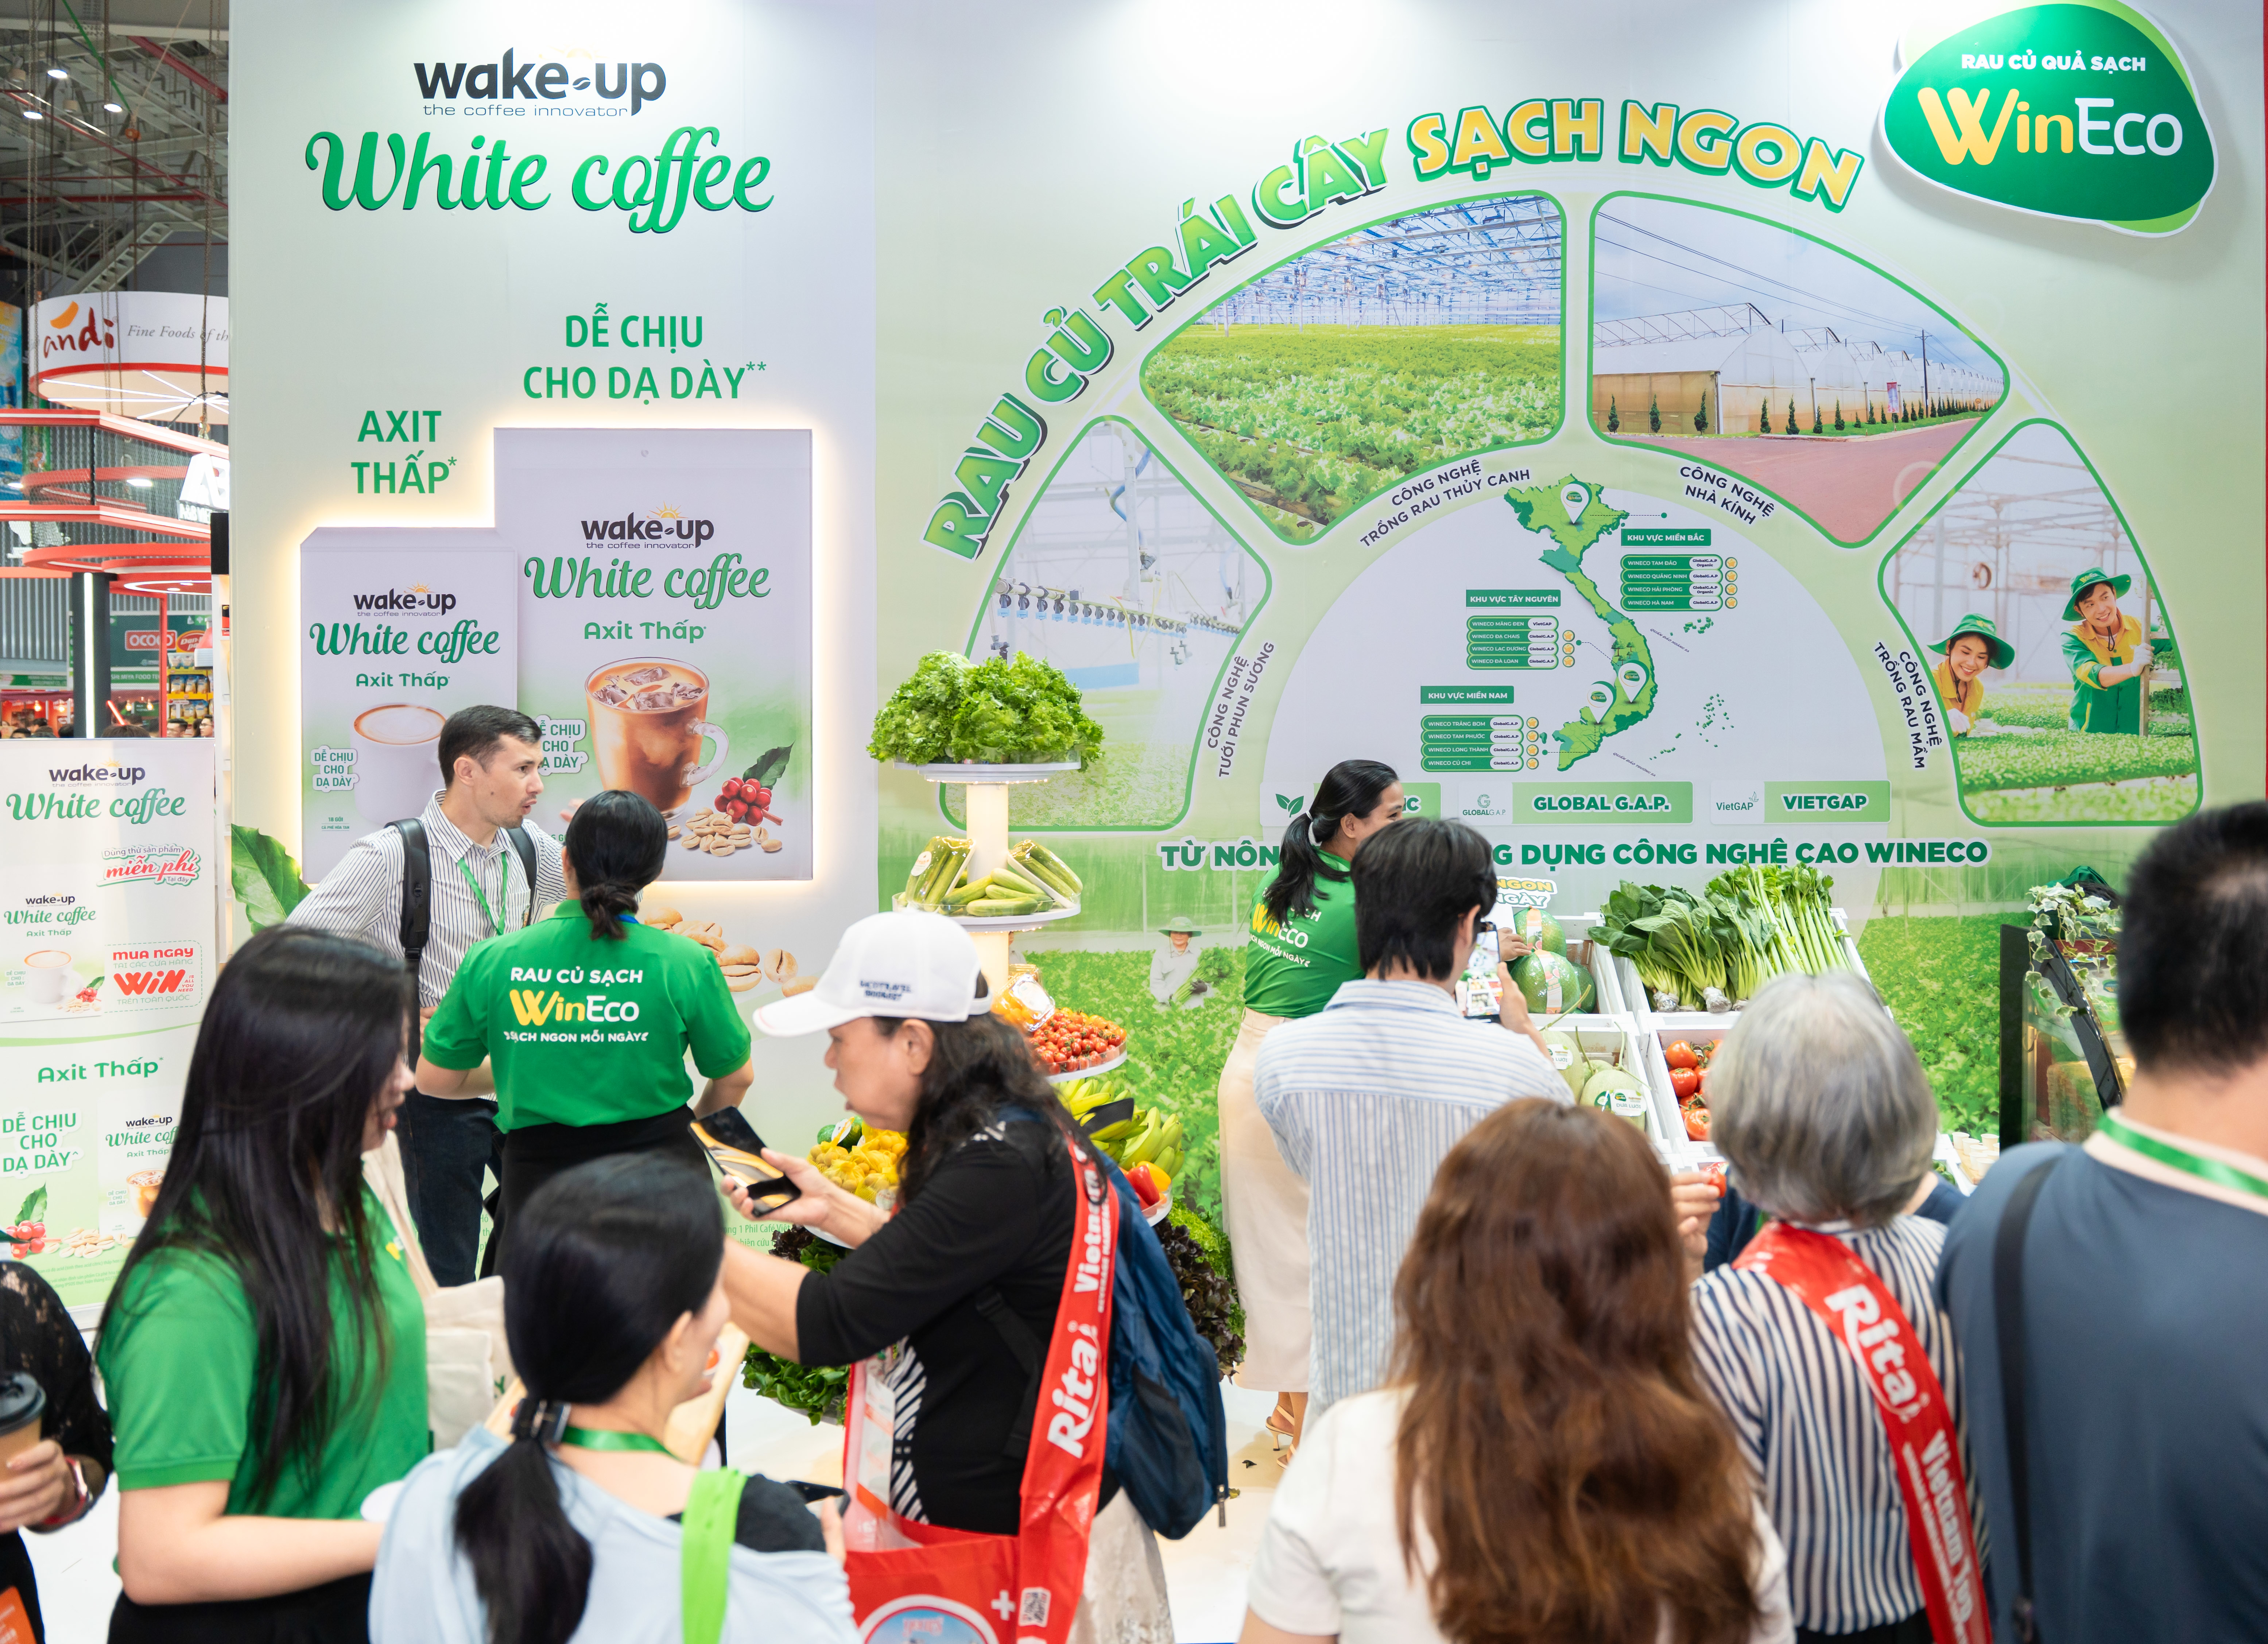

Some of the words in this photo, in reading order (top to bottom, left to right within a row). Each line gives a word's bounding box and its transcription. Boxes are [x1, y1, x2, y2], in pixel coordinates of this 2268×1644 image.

[1962, 54, 2004, 69] RAU
[2009, 49, 2036, 70] CỦ
[2042, 50, 2086, 70] QUẢ
[2091, 56, 2145, 74] SẠCH
[414, 47, 666, 116] wake-up
[423, 104, 455, 115] the
[465, 104, 525, 116] coffee
[533, 104, 627, 116] innovator
[1918, 86, 2183, 167] WinEco
[305, 132, 551, 211] White
[572, 127, 774, 234] coffee
[127, 325, 155, 336] Fine
[160, 326, 195, 338] Foods
[566, 303, 609, 347] DỄ
[621, 315, 703, 354] CHỊU
[920, 393, 1047, 562] RAU
[1026, 303, 1114, 403] CỦ
[1092, 194, 1258, 331] TRÁI
[1252, 128, 1389, 230] CÂY
[1407, 98, 1604, 182] SẠCH
[1619, 101, 1865, 213] NGON
[523, 366, 596, 399] CHO
[609, 367, 660, 405] DẠ
[357, 411, 441, 442] AXIT
[1392, 479, 1435, 506] CÔNG
[1438, 460, 1482, 485] NGHỆ
[1680, 466, 1727, 488] CÔNG
[1731, 483, 1775, 517] NGHỆ
[1360, 511, 1409, 547] TRỒNG
[1410, 495, 1441, 516] RAU
[1443, 479, 1483, 500] THỦY
[1488, 469, 1531, 486] CANH
[1685, 485, 1717, 505] NHÀ
[1721, 497, 1757, 524] KÍNH
[581, 512, 714, 548] wake-up
[524, 557, 654, 598] White
[664, 553, 771, 609] coffee
[353, 588, 456, 616] wake-up
[1489, 596, 1506, 604] VỰC
[310, 623, 409, 655] White
[418, 620, 500, 663] coffee
[585, 621, 633, 639] Axit
[356, 674, 393, 686] Axit
[1207, 703, 1228, 748] CÔNG
[1222, 656, 1249, 699] NGHỆ
[1219, 741, 1235, 776] TƯỚI
[1228, 696, 1249, 737] PHUN
[1244, 642, 1274, 693] SƯƠNG
[1875, 642, 1906, 693] TRỒNG
[1901, 696, 1919, 727] RAU
[1911, 732, 1928, 768] MẦM
[1900, 652, 1926, 696] CÔNG
[1920, 700, 1942, 746] NGHỆ
[551, 725, 580, 738] CHỊU
[315, 749, 326, 761] DỄ
[330, 753, 353, 763] CHỊU
[543, 741, 568, 752] CHO
[49, 764, 145, 785] wake-up
[317, 778, 329, 788] DẠ
[324, 765, 344, 774] CHO
[6, 793, 101, 820] White
[110, 788, 186, 824] coffee
[1534, 797, 1610, 810] GLOBAL
[1614, 795, 1670, 811] G.A.P.
[1783, 796, 1866, 809] VIETGAP
[104, 849, 126, 857] Dùng
[128, 846, 141, 854] thử
[143, 846, 158, 854] sản
[159, 845, 181, 854] phẩm
[1161, 840, 1206, 866] TỪ
[1215, 840, 1280, 866] NÔN
[1522, 844, 1605, 871] DỤNG
[1613, 838, 1697, 864] CÔNG
[1706, 838, 1787, 873] NGHỆ
[1796, 843, 1858, 866] CAO
[1865, 842, 1987, 863] WINECO
[104, 855, 160, 878] miễn
[157, 850, 198, 881] phí
[1258, 939, 1270, 951] NGON
[1283, 951, 1305, 965] NGÀY
[511, 967, 551, 982] RAU
[557, 966, 584, 983] CỦ
[589, 970, 643, 986] SẠCH
[509, 989, 639, 1025] WinEco
[540, 1033, 577, 1042] NGON
[581, 1030, 604, 1042] MỖI
[608, 1031, 642, 1042] NGÀY
[38, 1064, 87, 1083] Axit
[3, 1112, 25, 1133] DỄ
[32, 1113, 75, 1131] CHỊU
[20, 1133, 57, 1149] CHO
[3, 1156, 28, 1174] DẠ
[745, 1224, 757, 1233] Phil
[760, 1224, 775, 1233] Café
[1825, 1284, 1917, 1407] Rita
[1047, 1339, 1099, 1458] Rita
